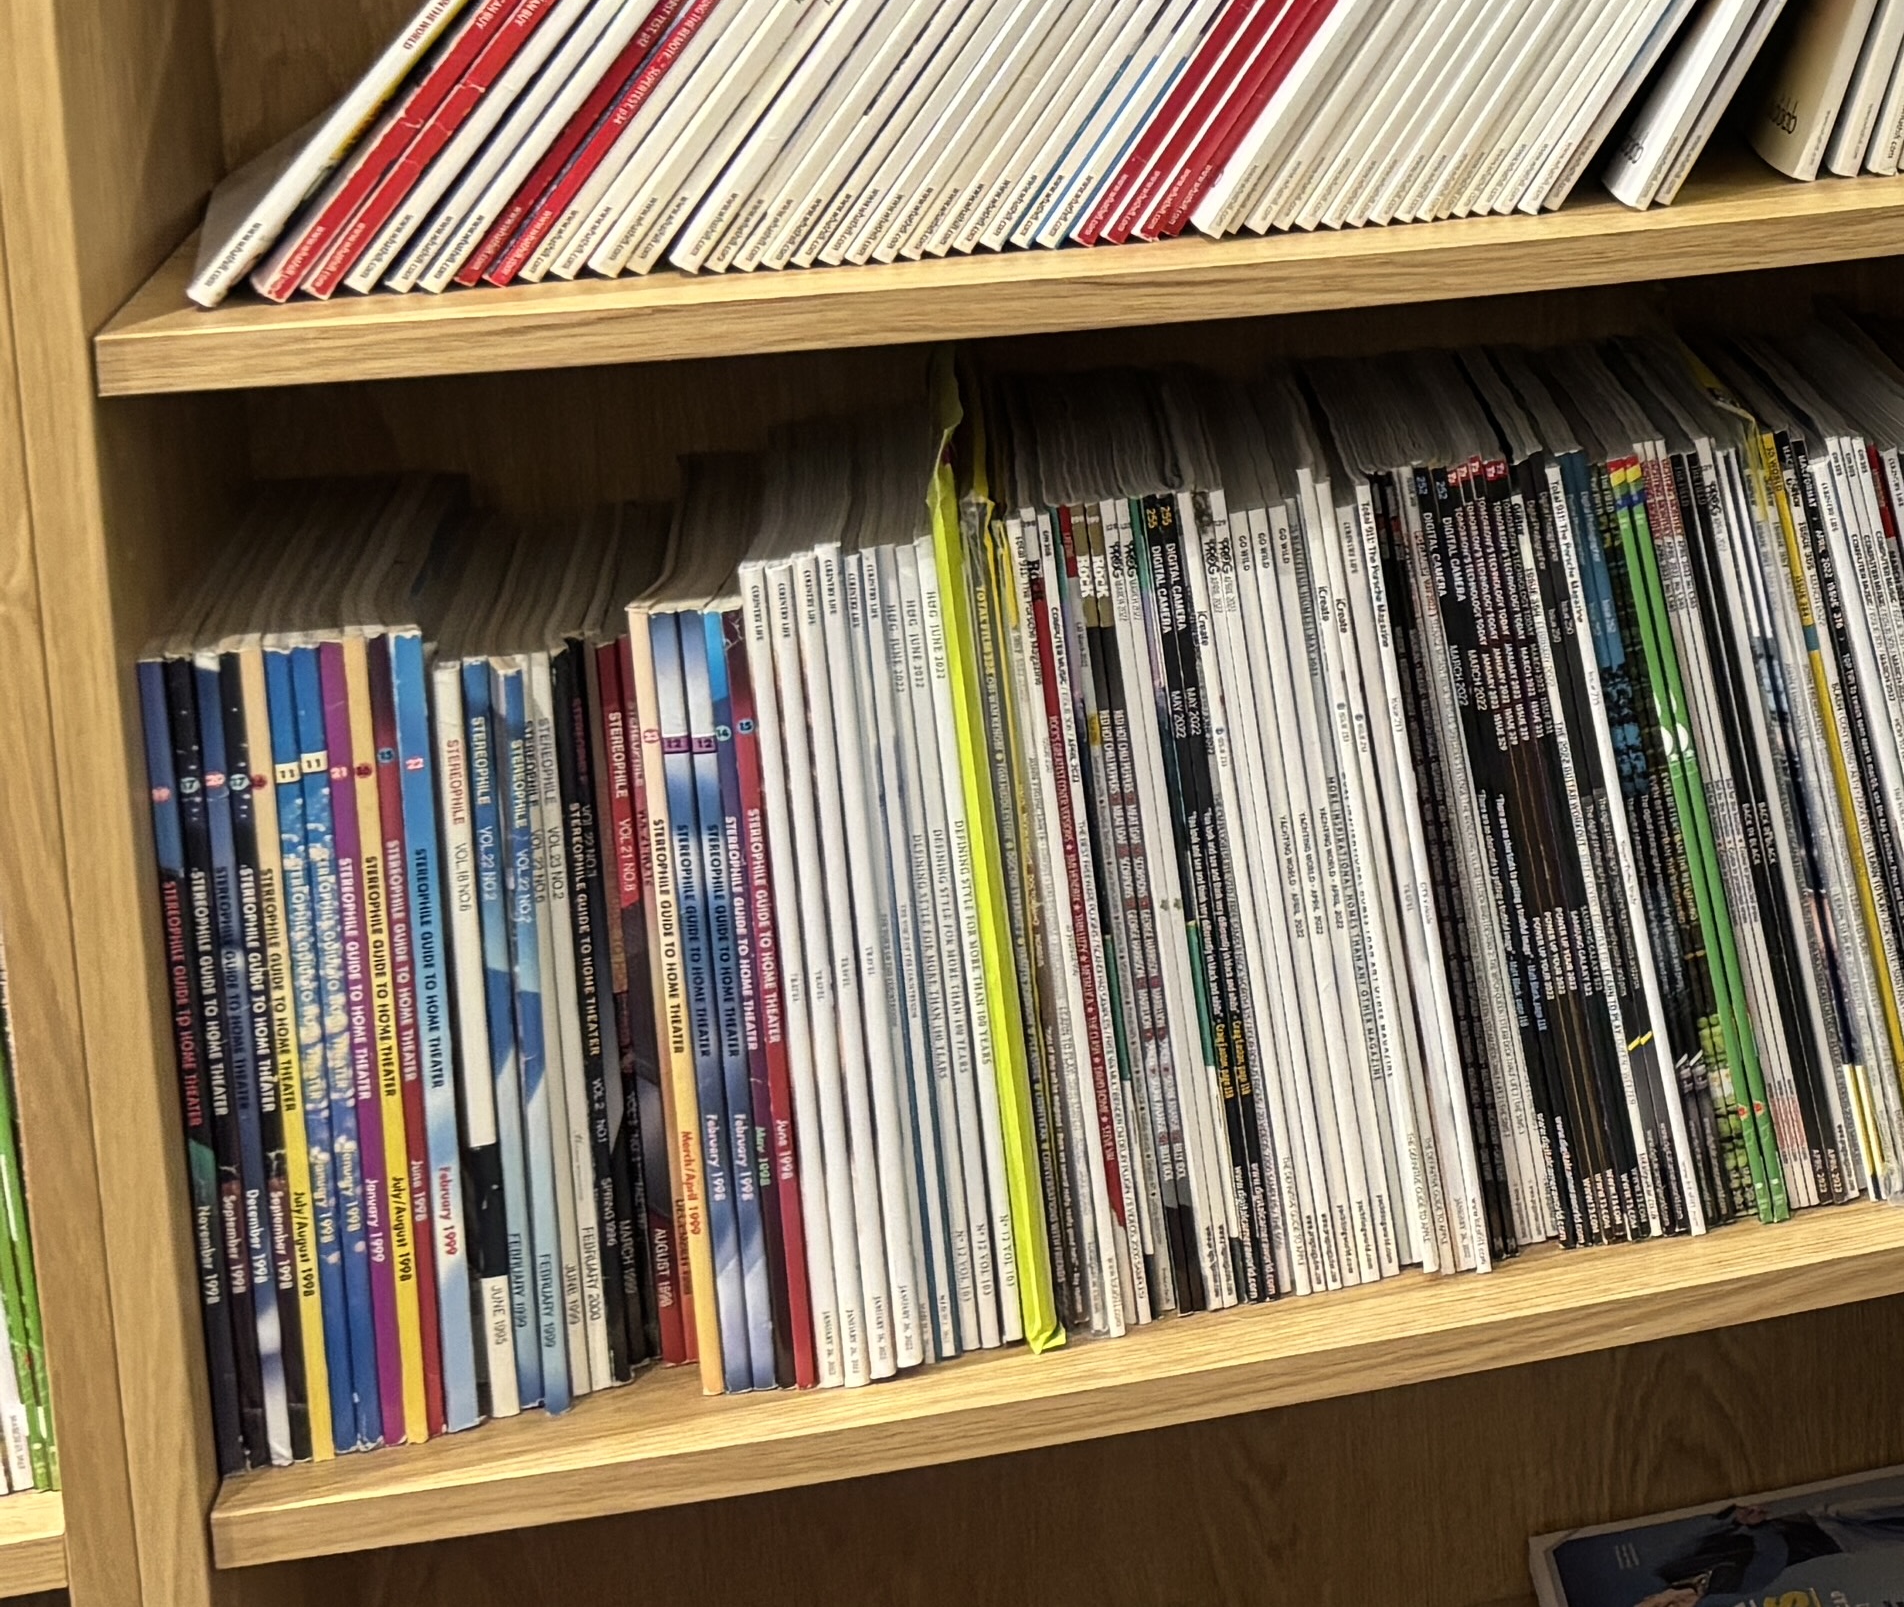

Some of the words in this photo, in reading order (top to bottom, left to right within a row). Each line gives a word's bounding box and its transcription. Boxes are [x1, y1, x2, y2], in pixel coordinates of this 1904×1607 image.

[1150, 545, 1165, 585] DIGITAL
[1422, 511, 1438, 552] DIGITAL
[1431, 553, 1447, 597] CAMERA
[1156, 586, 1172, 633] CAMERA
[445, 739, 465, 824] STEREOPHILE
[650, 819, 669, 896] STEREOPHILE
[745, 808, 765, 886] STEREOPHILE
[337, 857, 358, 936] STEREOPHILE
[362, 855, 384, 936] STEREOPHILE
[411, 848, 433, 925] STEREOPHILE
[658, 899, 673, 937] GUIDE
[753, 889, 769, 928] GUIDE
[419, 932, 437, 969] GUIDE
[662, 941, 675, 957] TO
[757, 931, 771, 947] TO
[345, 941, 362, 979] GUIDE
[370, 940, 388, 978] GUIDE
[759, 951, 775, 988] HOME
[349, 984, 364, 1001] TO
[374, 981, 390, 999] TO
[423, 975, 439, 991] TO
[664, 962, 679, 998] HOME
[351, 1006, 368, 1043] HOME
[376, 1003, 394, 1041] HOME
[425, 996, 443, 1036] HOME
[667, 1003, 684, 1054] THEATER
[762, 992, 780, 1043] THEATER
[354, 1048, 370, 1100] THEATER
[380, 1045, 396, 1096] THEATER
[427, 1038, 445, 1088] THEATER
[775, 1118, 791, 1146] June
[678, 1130, 699, 1201] March/April
[779, 1150, 793, 1179] 1998
[364, 1177, 381, 1227] January
[388, 1175, 409, 1247] July/August
[434, 1165, 455, 1221] February
[369, 1232, 384, 1262] 1999
[443, 1225, 457, 1255] 1999
[397, 1252, 411, 1281] 1998
[488, 1284, 504, 1317] JUNE
